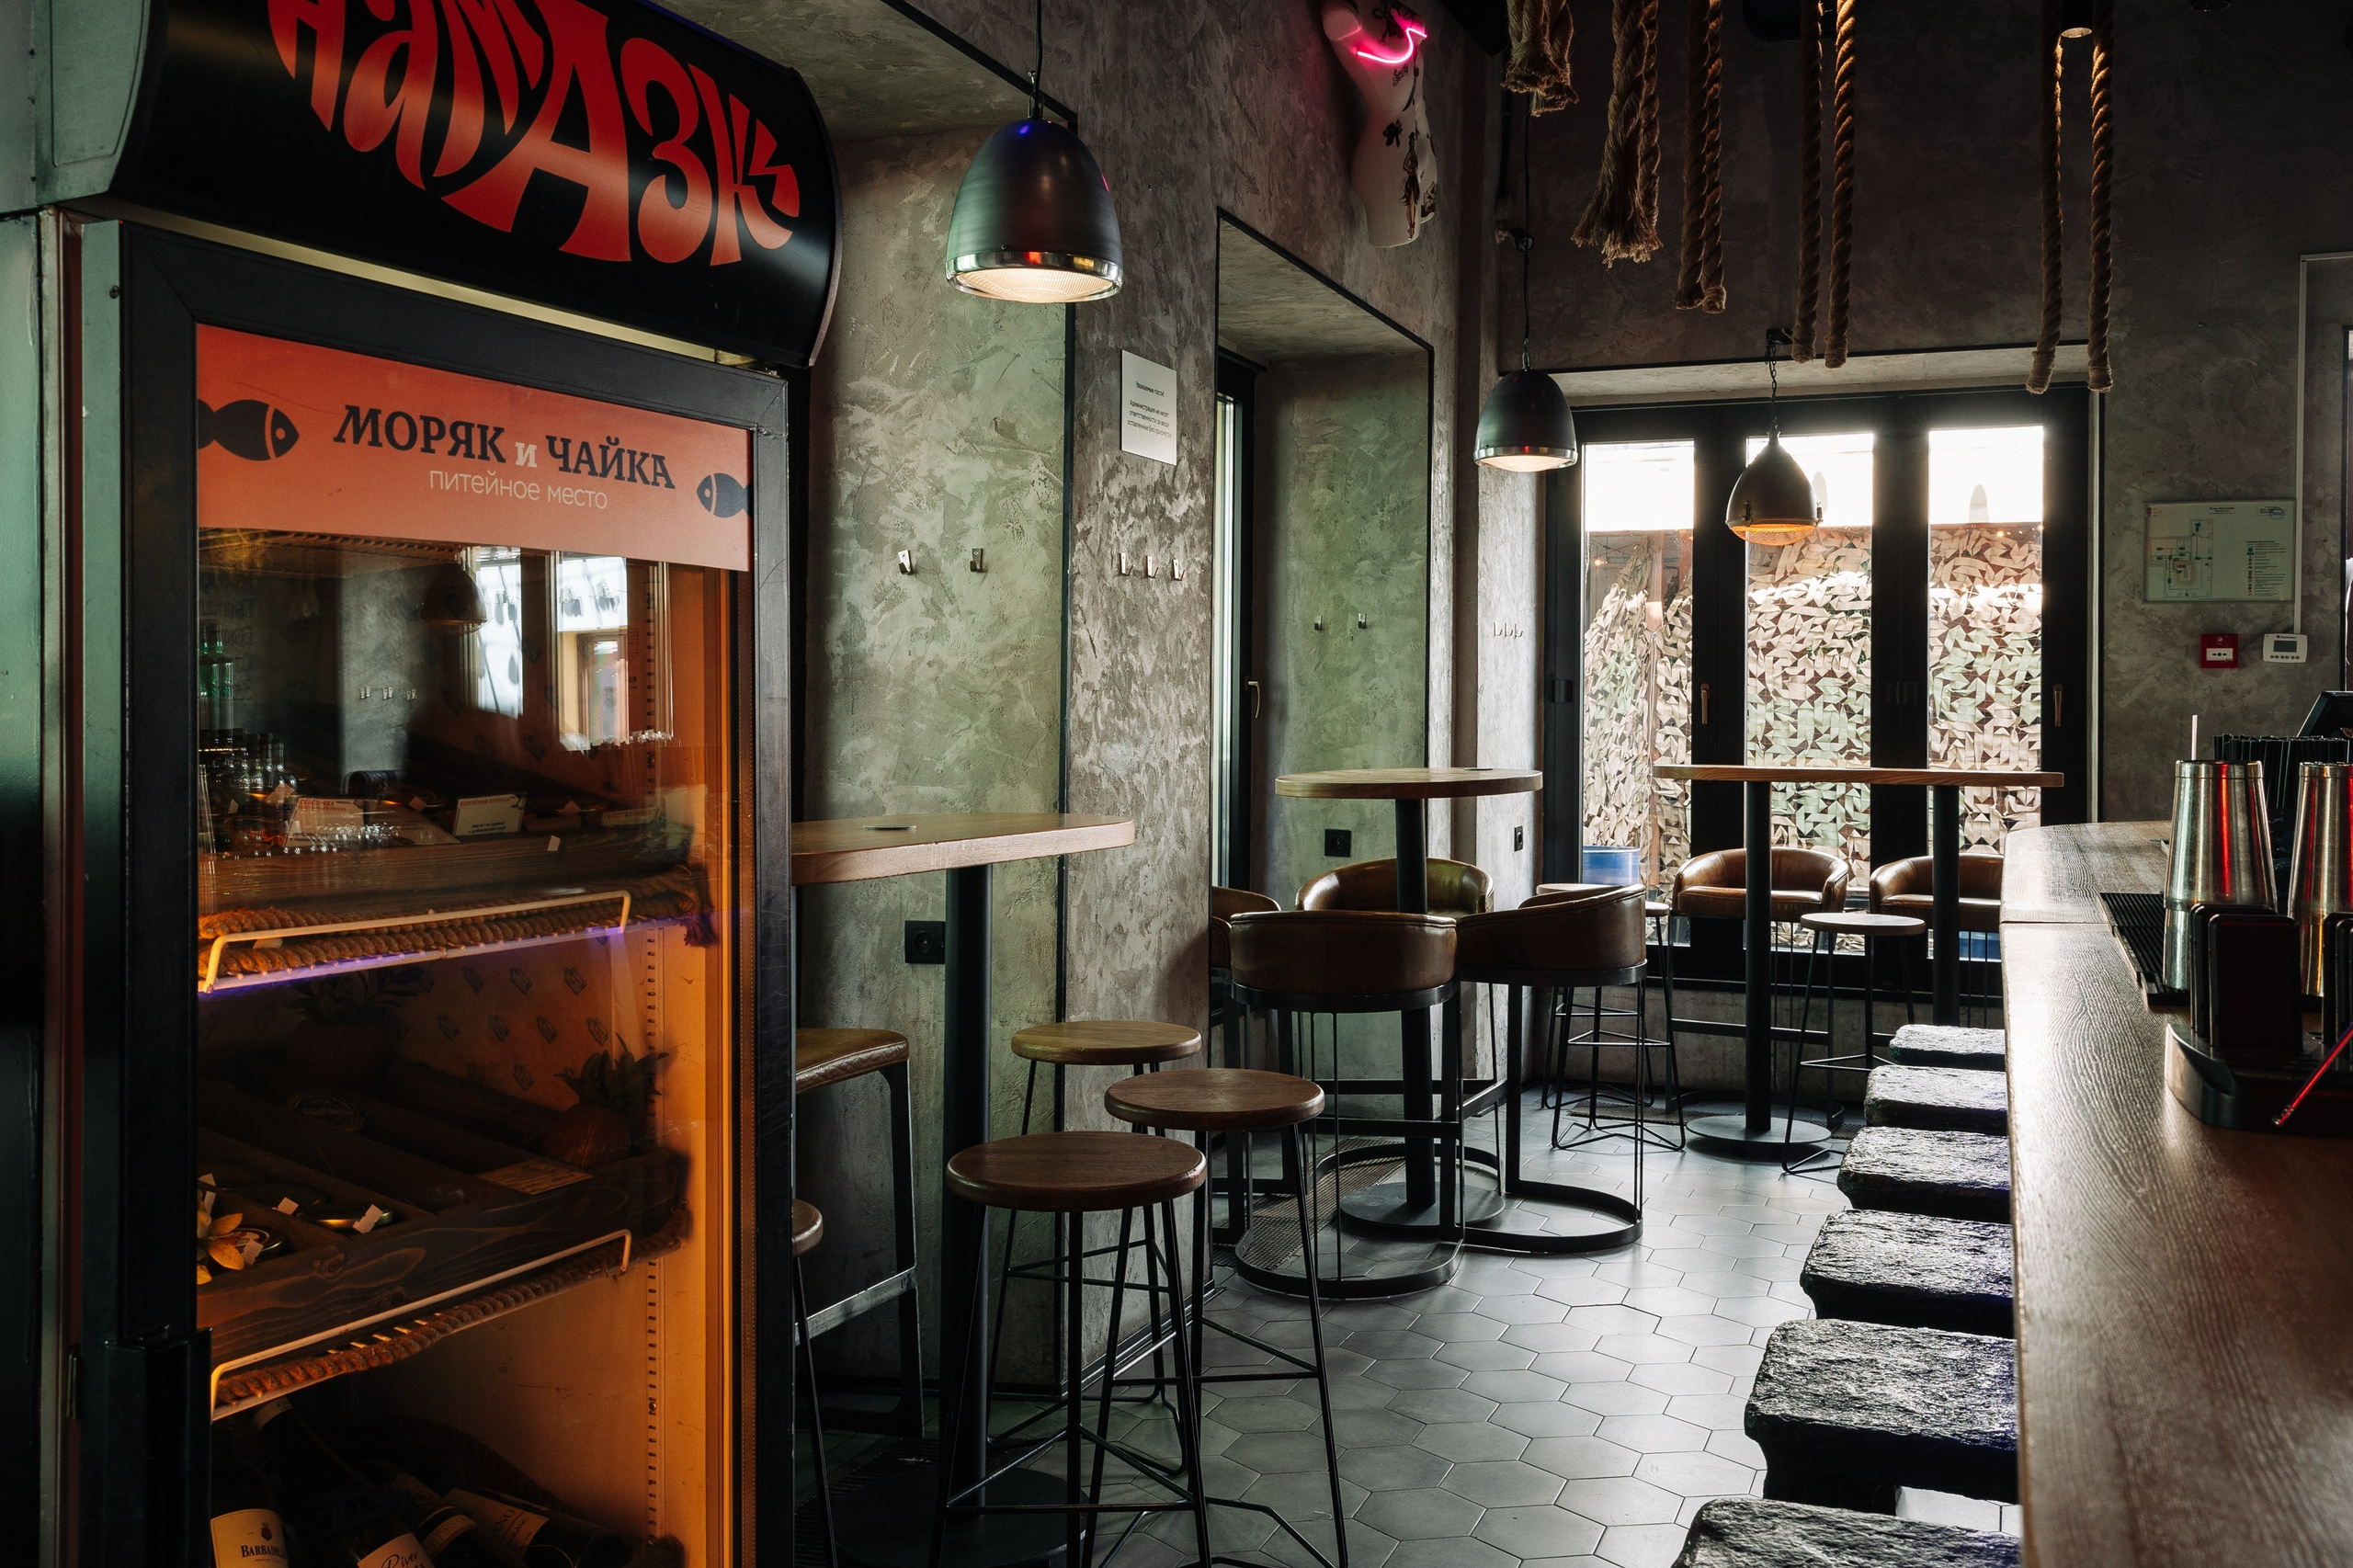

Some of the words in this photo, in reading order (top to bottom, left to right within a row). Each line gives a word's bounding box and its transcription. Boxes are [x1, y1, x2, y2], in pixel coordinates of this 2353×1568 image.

[333, 404, 506, 463] МОРЯК
[515, 442, 538, 469] и
[545, 435, 676, 489] ЧАЙКА
[429, 470, 540, 501] питейное
[548, 485, 608, 509] место
